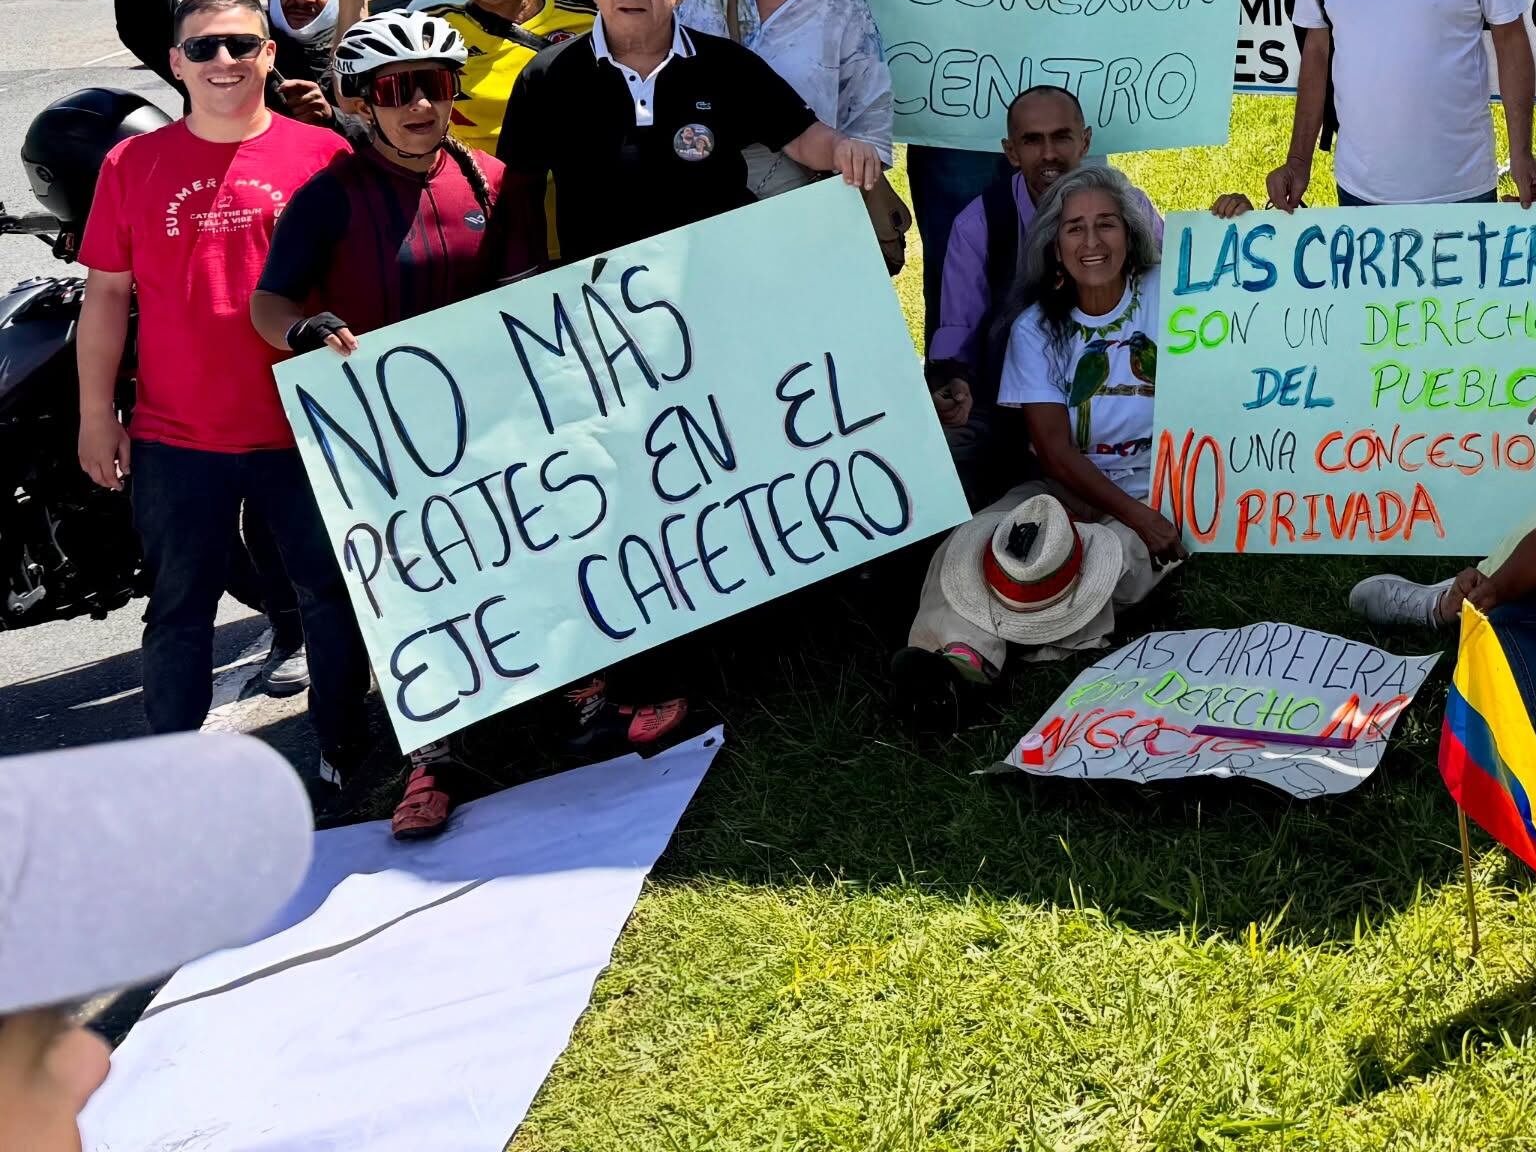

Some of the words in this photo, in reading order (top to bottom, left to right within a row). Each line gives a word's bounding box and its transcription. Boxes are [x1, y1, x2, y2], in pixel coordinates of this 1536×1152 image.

[884, 41, 1197, 128] CENTRO
[166, 177, 217, 237] SUMMER
[1173, 223, 1278, 295] LAS
[1166, 301, 1260, 355] SON
[1284, 303, 1334, 349] UN
[296, 344, 469, 510] NO
[500, 257, 693, 435] MÁS
[1242, 364, 1335, 410] DEL
[344, 451, 607, 619] PEAJES
[645, 394, 738, 503] EN
[776, 352, 886, 449] EL
[1151, 426, 1226, 544] NO
[1229, 428, 1297, 474] UNA
[1234, 482, 1446, 554] PRIVADA
[391, 595, 539, 723] EJE
[578, 449, 914, 640] CAFETERO
[1186, 623, 1442, 698] CARRETERAS
[1143, 670, 1323, 733] DERECHO
